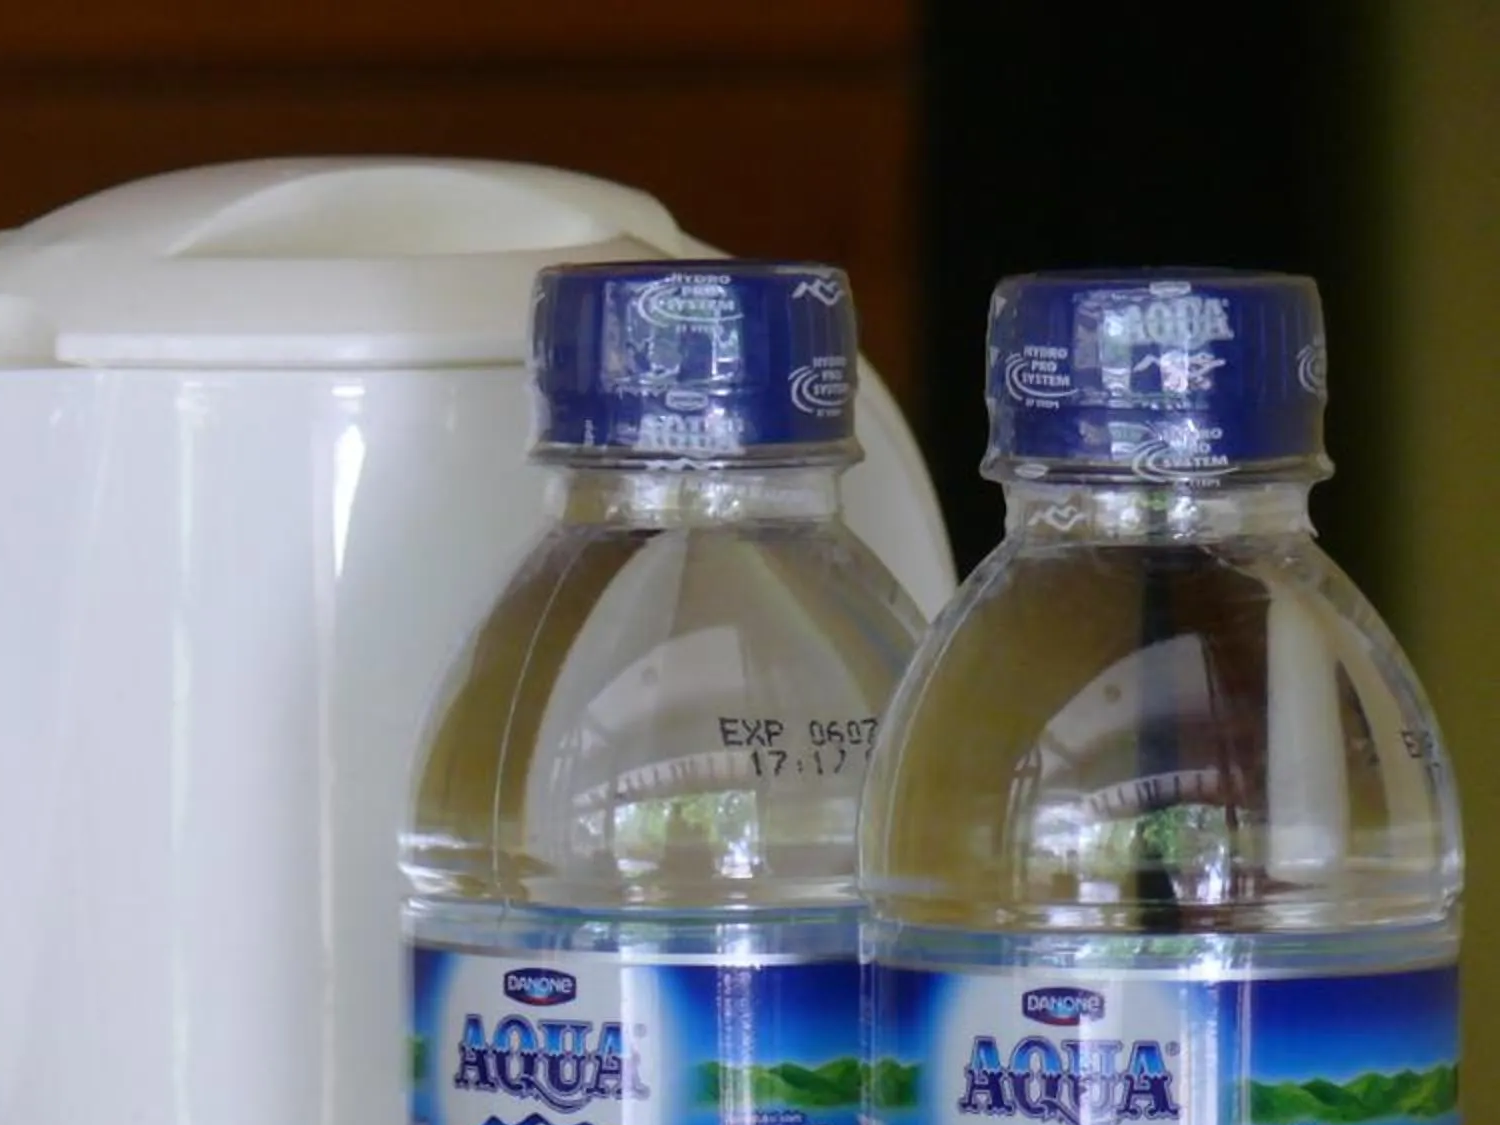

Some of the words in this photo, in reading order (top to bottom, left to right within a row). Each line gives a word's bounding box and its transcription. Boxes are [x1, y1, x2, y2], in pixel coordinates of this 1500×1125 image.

[1023, 346, 1068, 360] HYDRO
[1031, 360, 1057, 373] PRO
[1021, 373, 1070, 387] SYSTEM
[719, 717, 784, 747] EXP
[454, 1013, 651, 1113] AQUA
